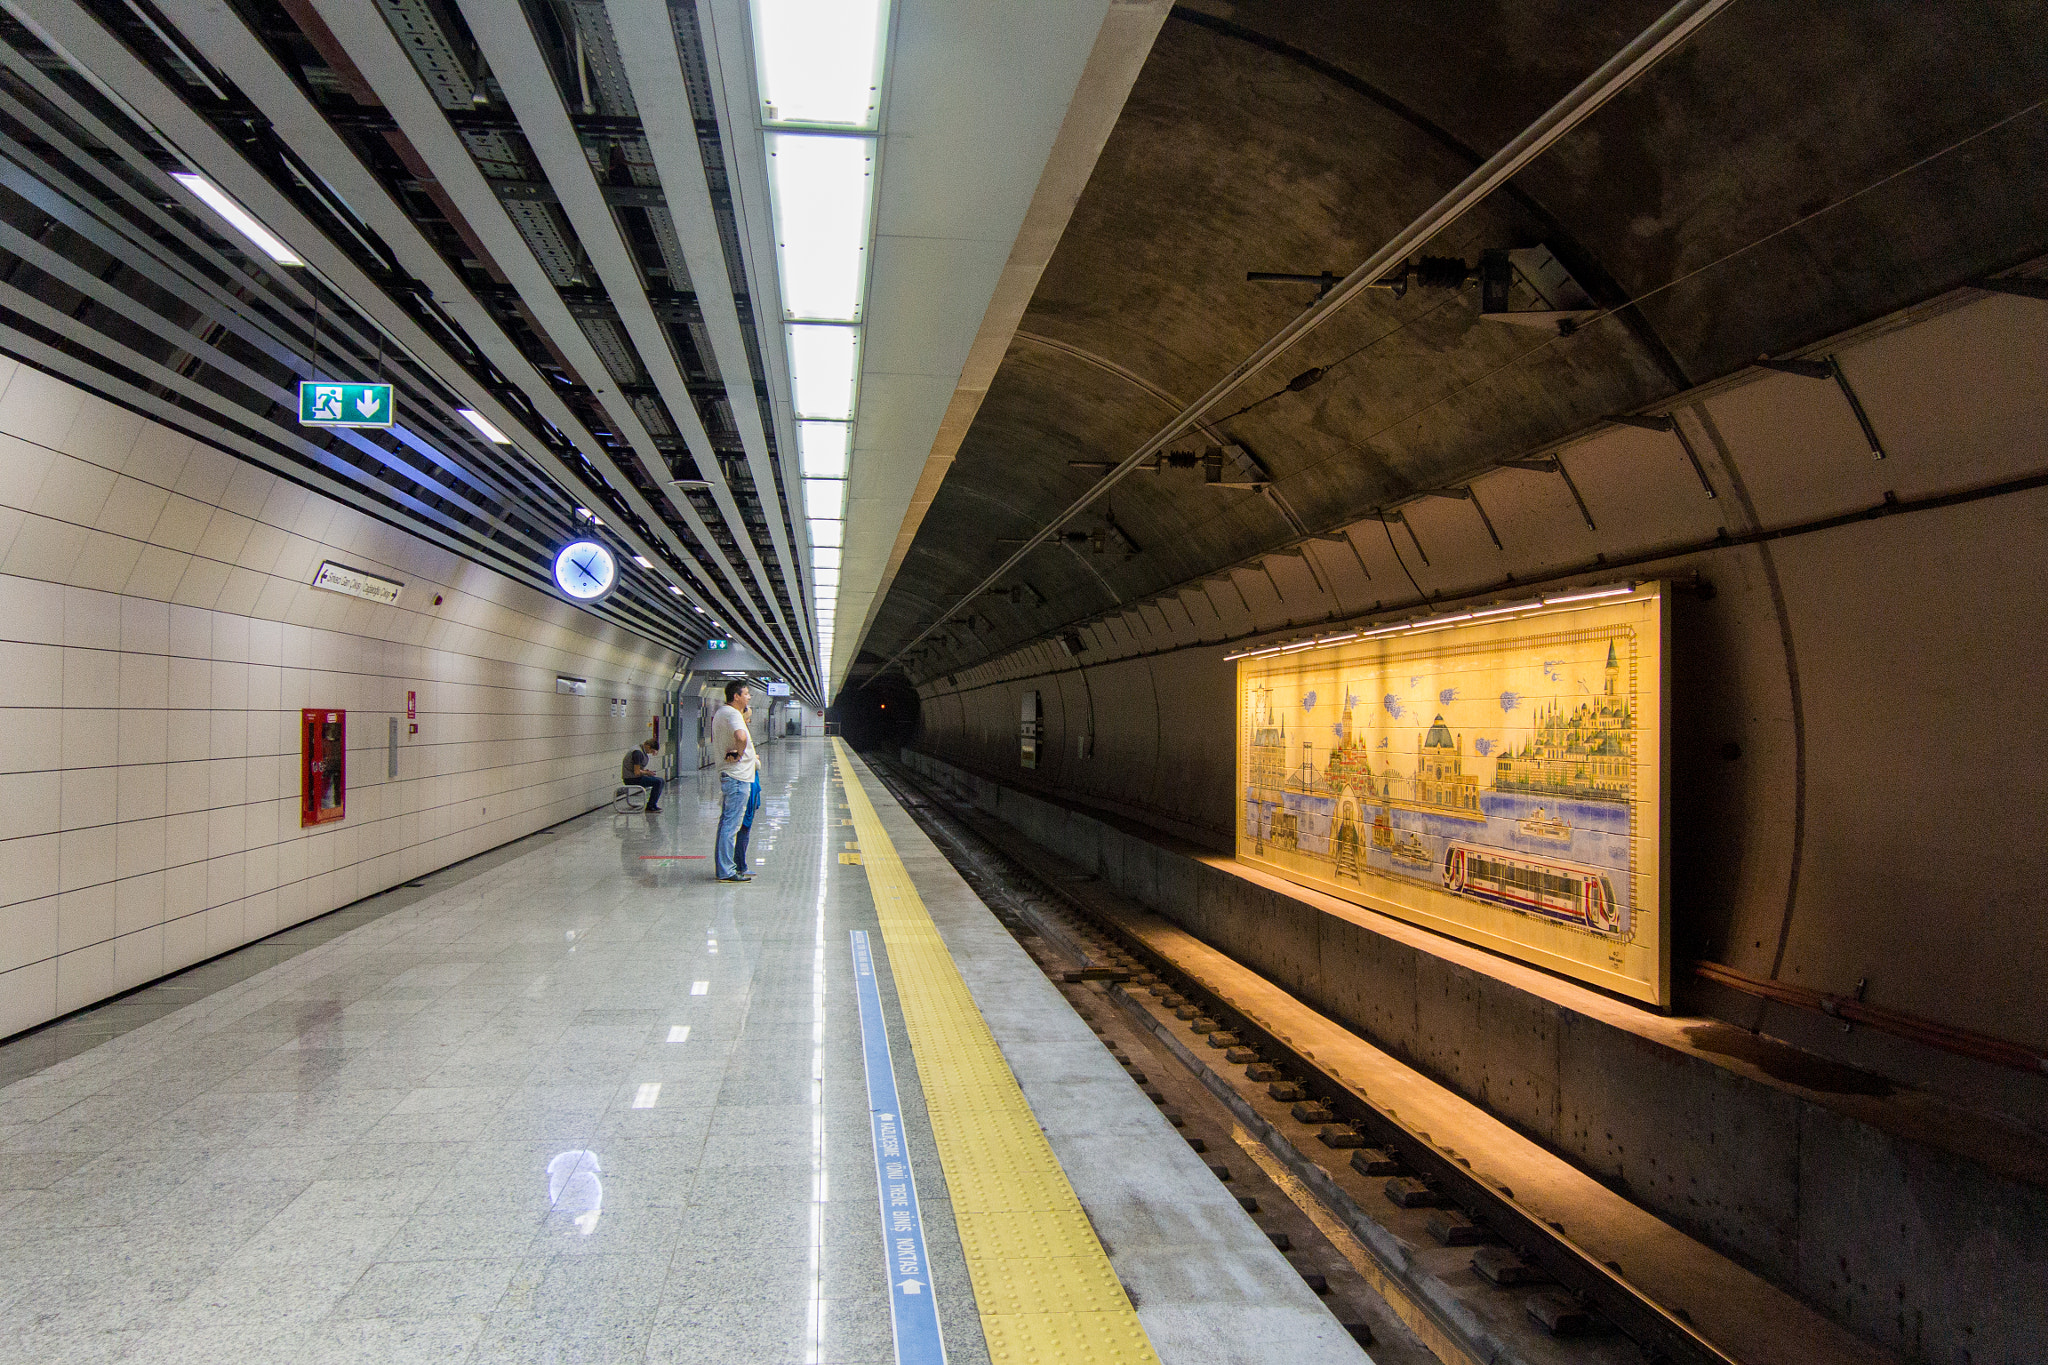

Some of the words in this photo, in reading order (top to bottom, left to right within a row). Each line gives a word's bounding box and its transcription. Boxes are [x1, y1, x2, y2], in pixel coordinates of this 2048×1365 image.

[879, 1122, 900, 1157] KAZLIÇEŞME
[886, 1162, 908, 1179] YÖNÜ
[890, 1183, 909, 1207] TRENE
[890, 1211, 917, 1232] BİNİŞ
[896, 1238, 919, 1275] NOKTASI
